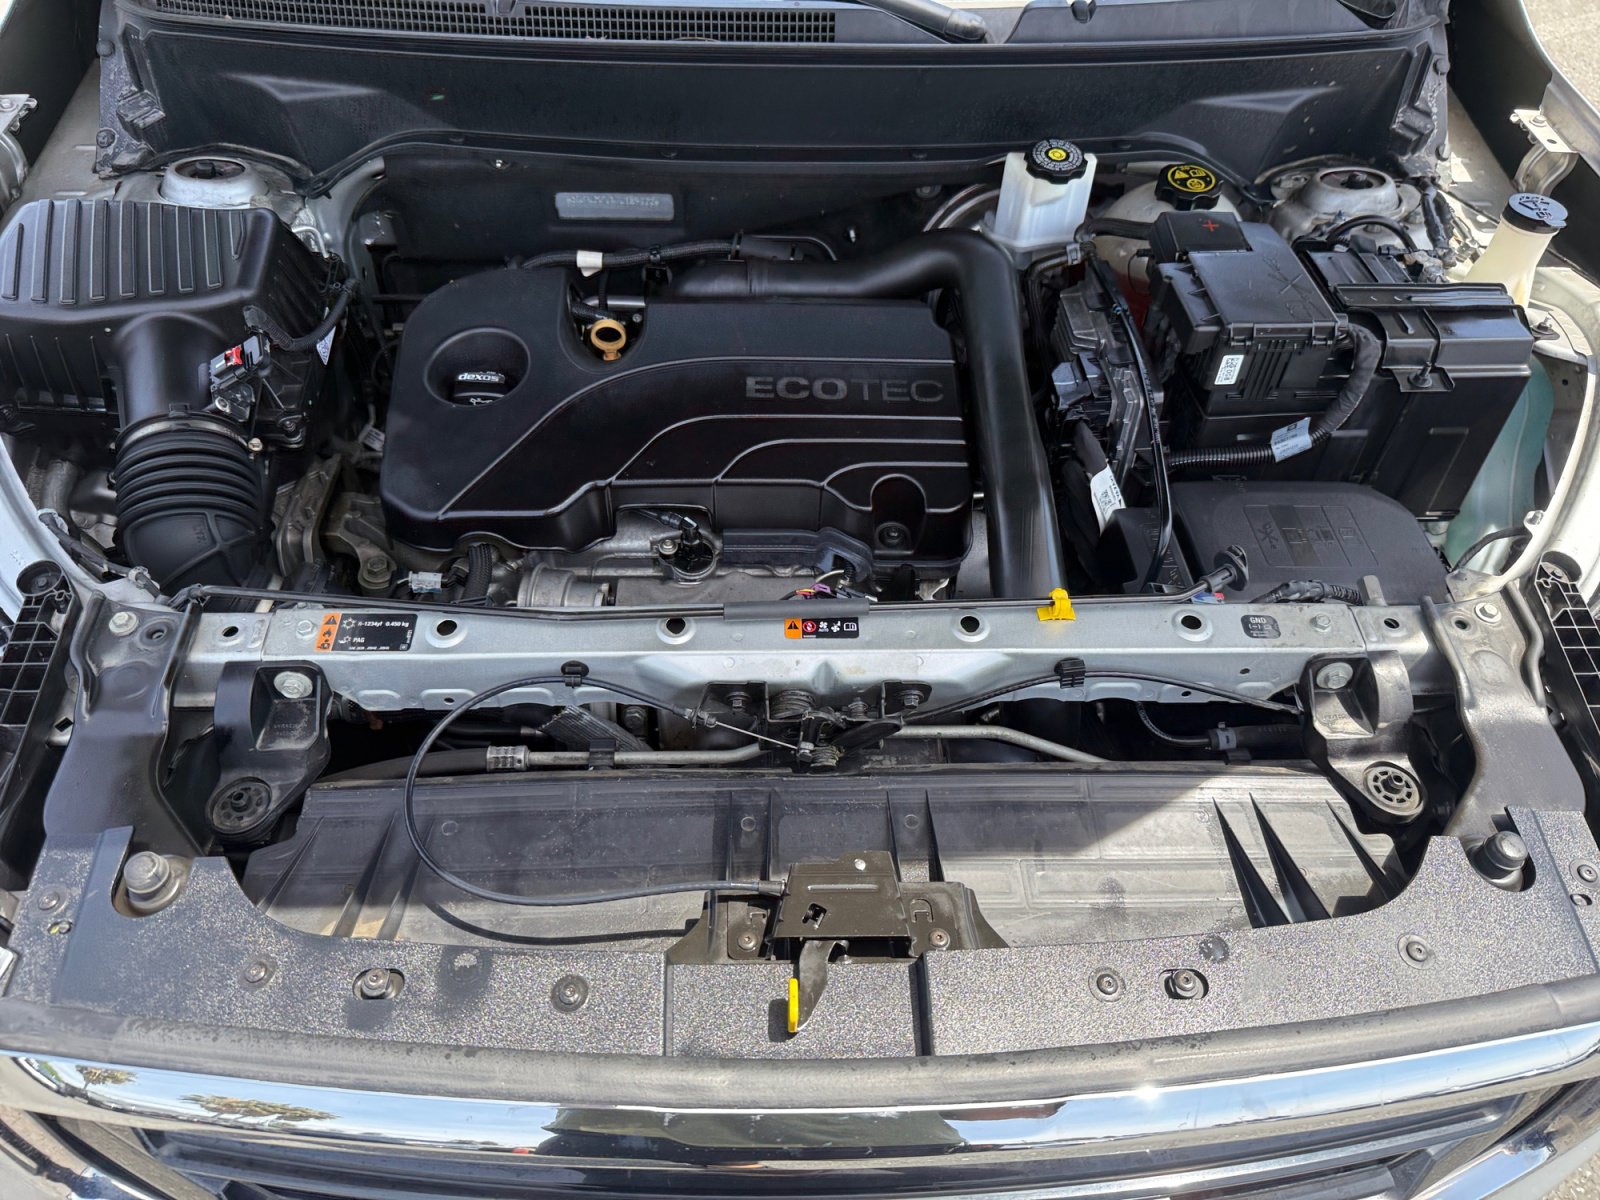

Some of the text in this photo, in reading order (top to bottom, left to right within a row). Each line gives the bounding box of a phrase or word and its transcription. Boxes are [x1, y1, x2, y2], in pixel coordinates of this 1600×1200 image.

[458, 372, 499, 382] dexos
[745, 375, 944, 402] ECOTEC
[1249, 616, 1267, 624] GND
